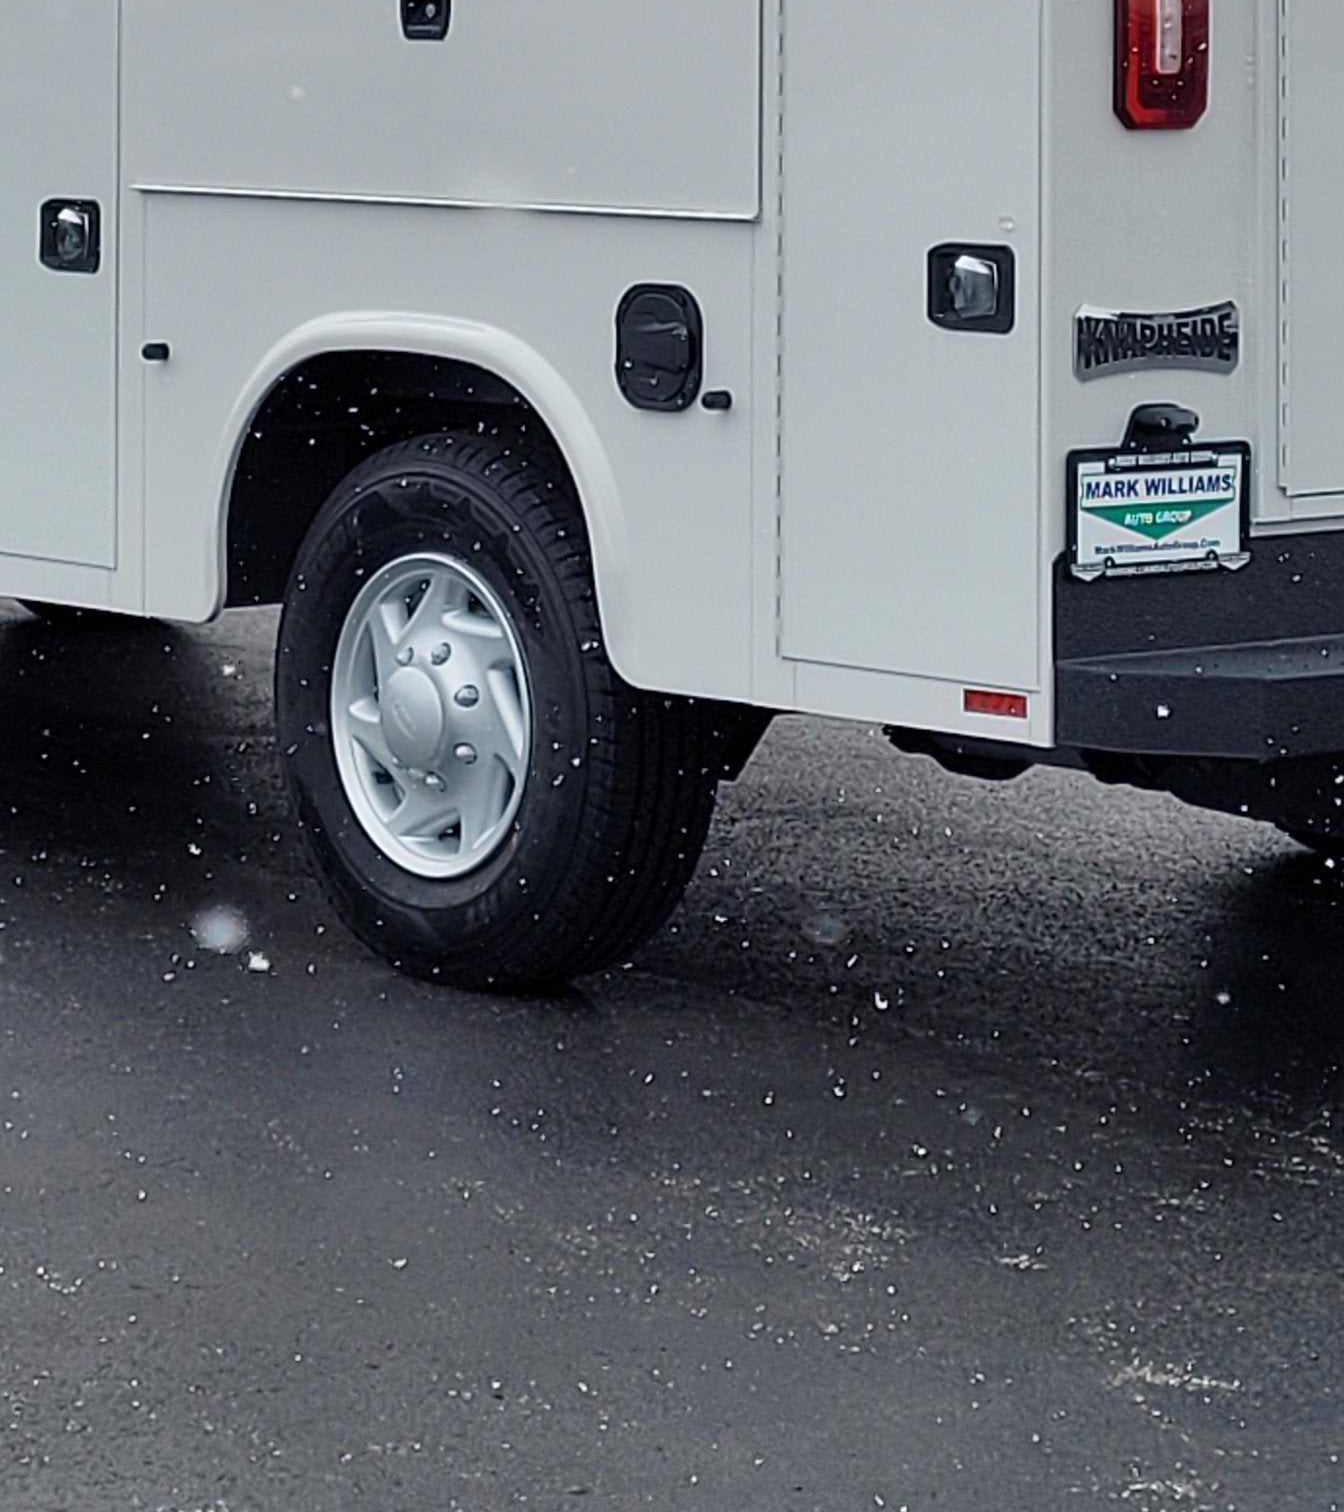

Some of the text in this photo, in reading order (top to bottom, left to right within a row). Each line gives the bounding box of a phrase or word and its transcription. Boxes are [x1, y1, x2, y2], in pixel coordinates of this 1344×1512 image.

[1077, 310, 1238, 370] KNAPHEIDE
[1085, 474, 1232, 499] MARK WILLIAMS
[1124, 509, 1193, 526] AUTO GROUP
